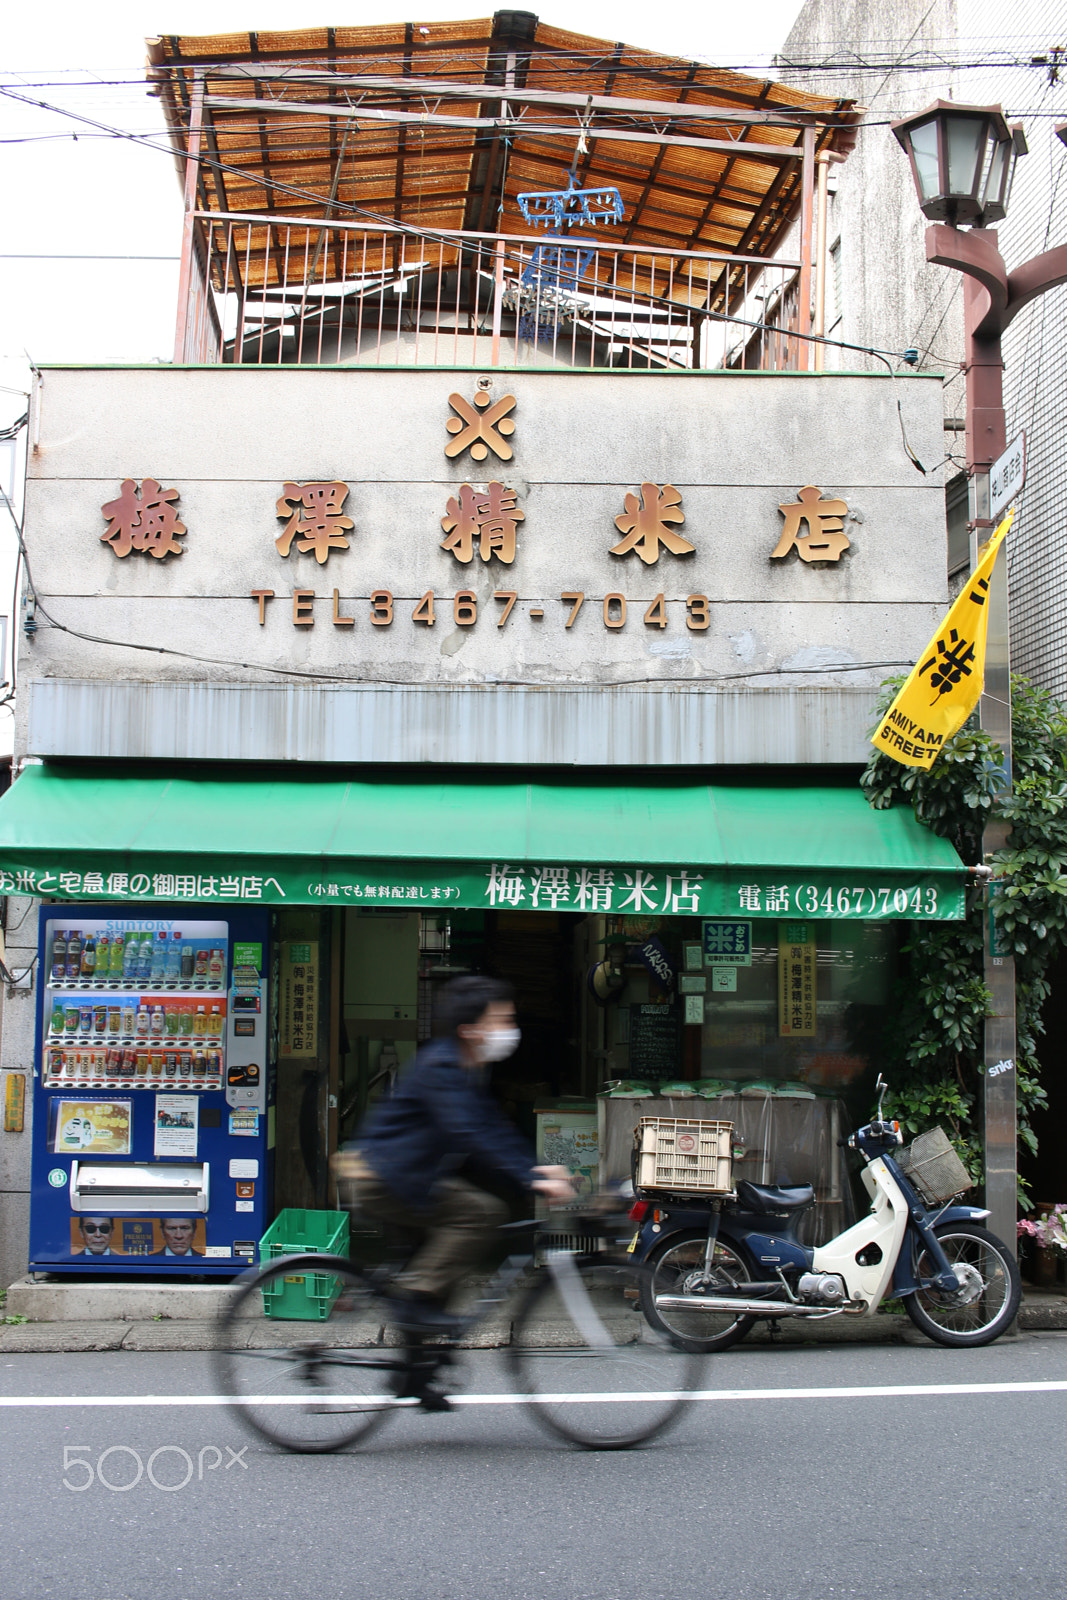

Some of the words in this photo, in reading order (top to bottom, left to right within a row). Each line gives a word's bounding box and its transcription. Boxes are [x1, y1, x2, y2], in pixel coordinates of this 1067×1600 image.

[100, 477, 853, 565] 梅澤精米店
[881, 725, 938, 759] STREET
[0, 871, 286, 898] お米と宅急便の御用は当店へ
[484, 863, 704, 914] 梅澤精米店
[106, 920, 174, 931] SUNTORY
[735, 925, 745, 952] おこめ
